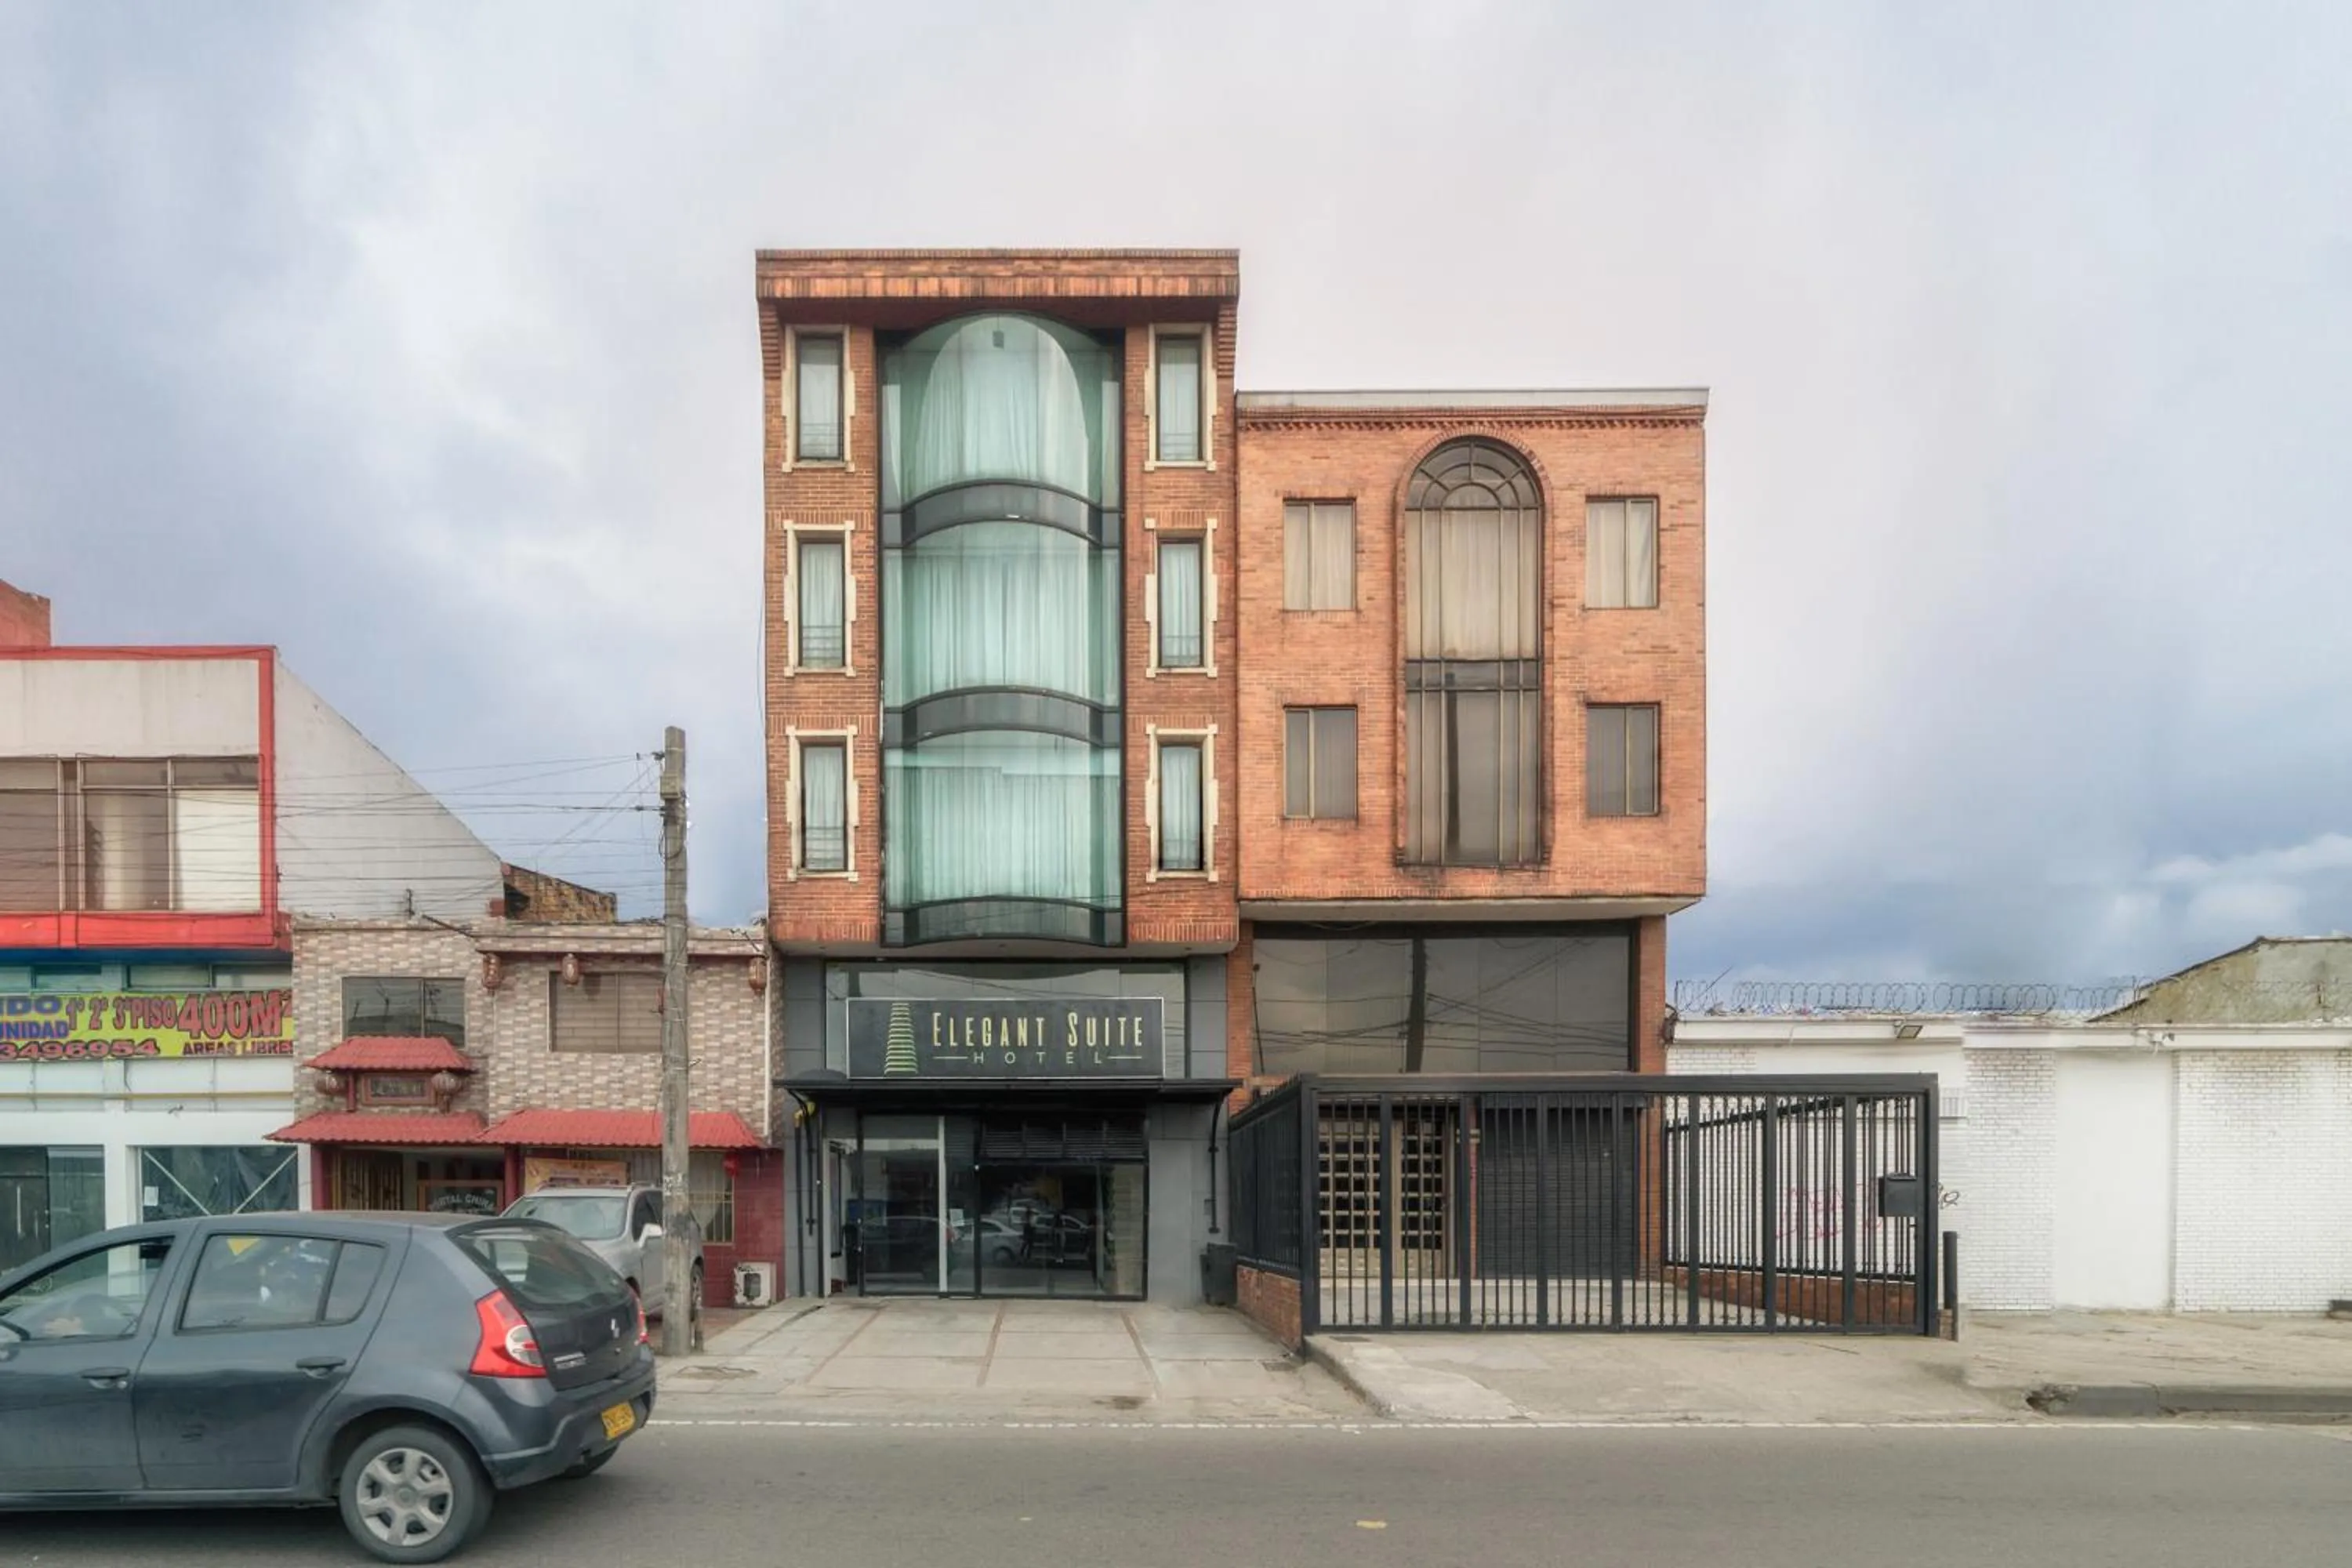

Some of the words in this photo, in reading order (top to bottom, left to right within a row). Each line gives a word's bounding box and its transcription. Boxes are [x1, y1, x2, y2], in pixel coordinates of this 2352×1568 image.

[0, 995, 61, 1016] DO
[0, 1021, 68, 1039] NIDAD
[931, 1011, 1045, 1047] ELEGANT
[1067, 1011, 1142, 1047] SUITE
[973, 1051, 1102, 1064] HOTEL
